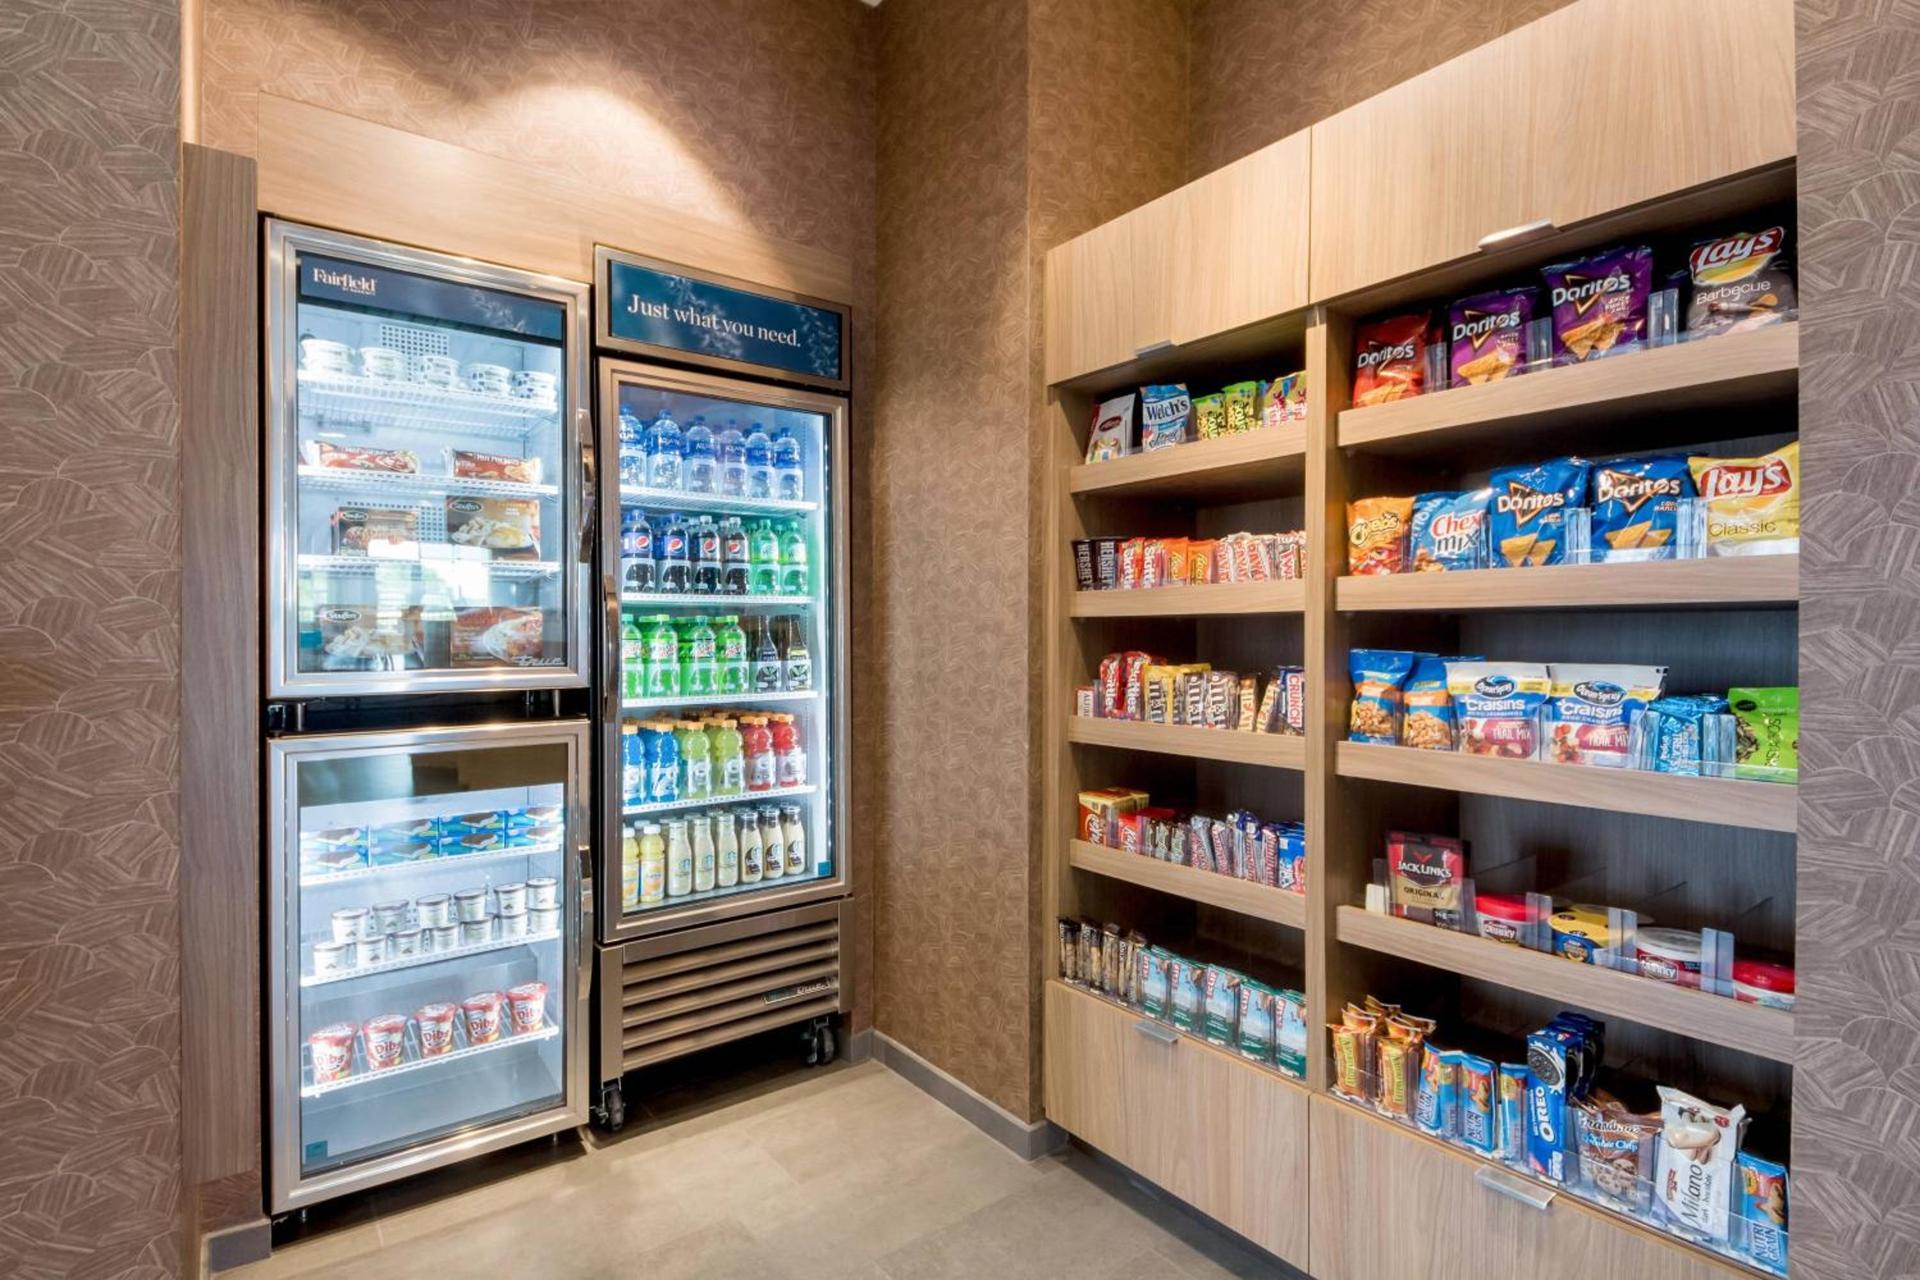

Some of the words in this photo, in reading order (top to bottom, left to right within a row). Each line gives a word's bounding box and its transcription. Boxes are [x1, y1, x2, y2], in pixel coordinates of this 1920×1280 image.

[313, 267, 376, 292] Fairfield
[1551, 273, 1631, 308] Doritos
[1696, 280, 1772, 306] Barbecue
[627, 293, 671, 321] Just
[674, 305, 720, 330] what
[721, 318, 754, 338] you
[758, 326, 801, 348] need.
[1453, 310, 1521, 341] Doritos
[1357, 343, 1415, 368] Doritos
[1145, 399, 1189, 421] Welch's
[1497, 491, 1564, 513] Doritos
[1598, 477, 1681, 503] Doritos
[1431, 510, 1482, 537] Chex
[1709, 520, 1777, 537] Classic
[1288, 675, 1302, 727] CRUNCH
[1467, 699, 1526, 711] Craisins
[1561, 701, 1623, 719] Craisins
[1397, 860, 1420, 875] JACK
[1419, 863, 1452, 878] LINK'S
[1535, 1085, 1556, 1143] OREO
[1680, 1163, 1704, 1224] Milano
[1752, 1222, 1767, 1257] NUTRI
[1763, 1226, 1779, 1262] GRAIN
